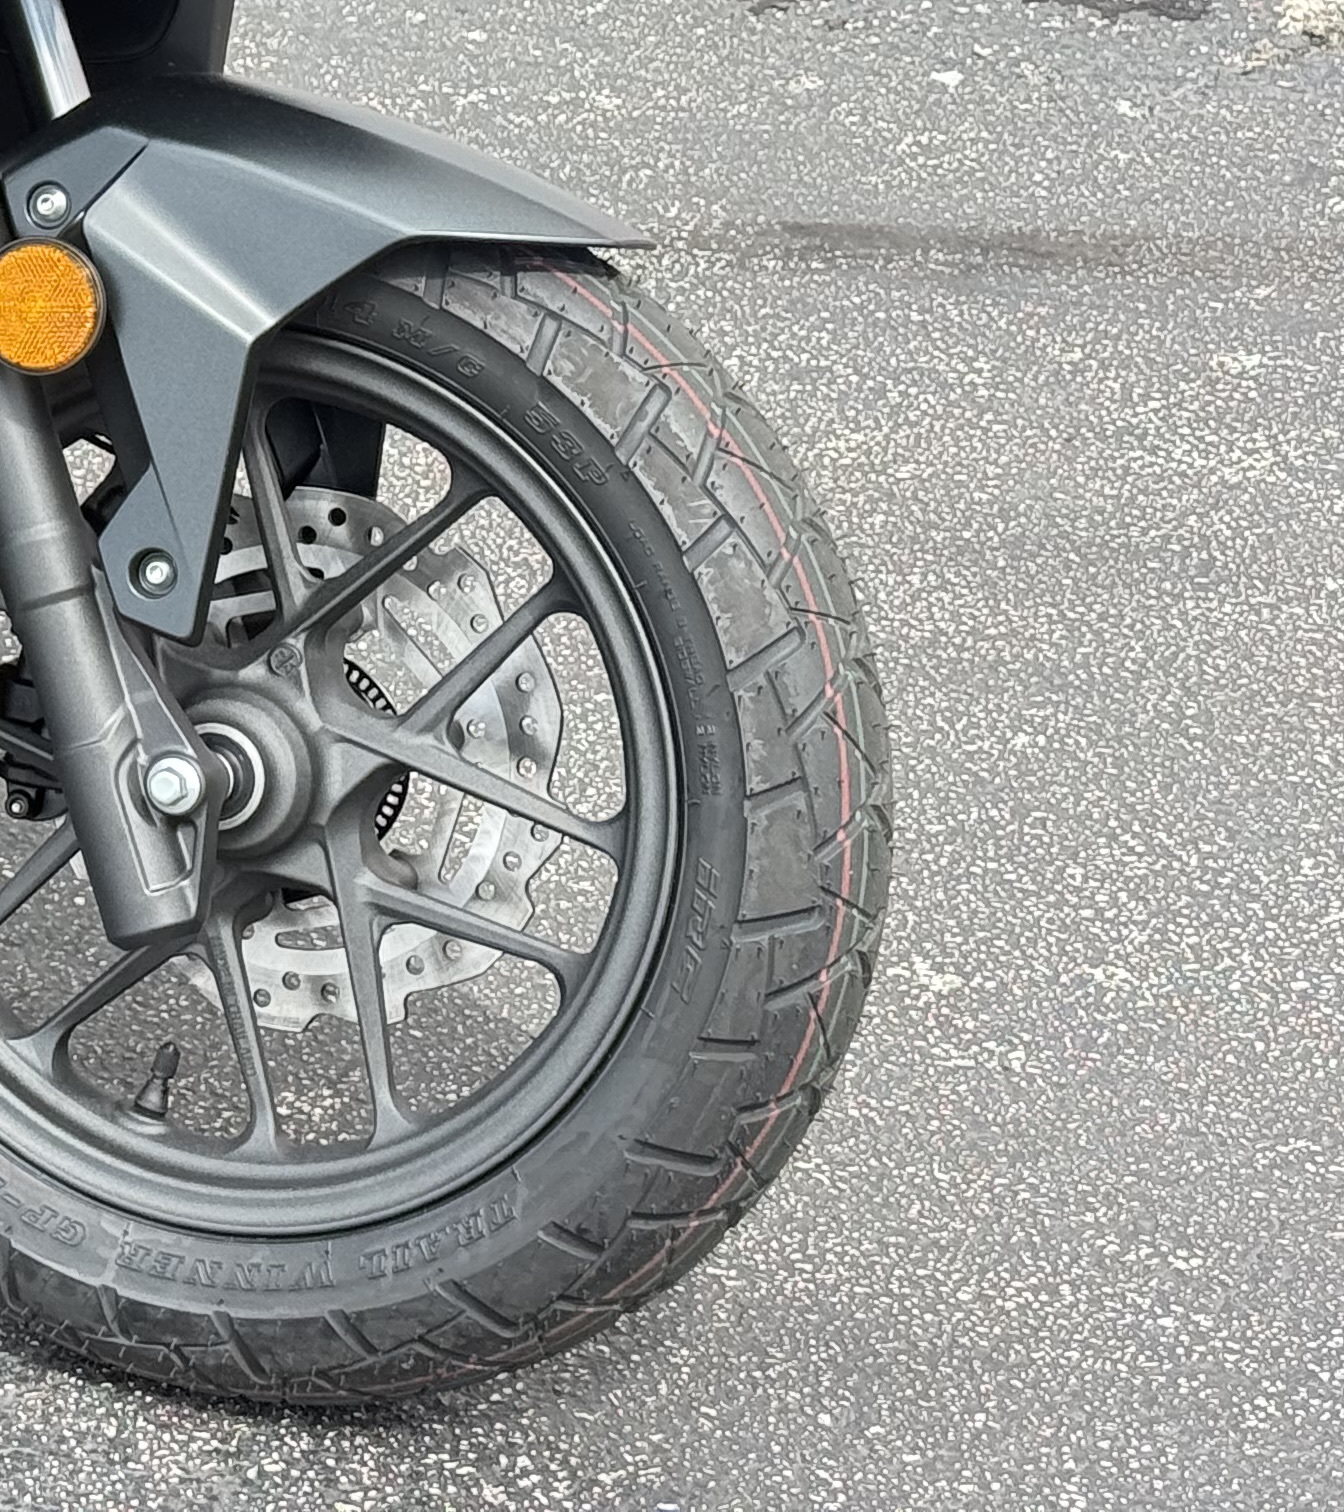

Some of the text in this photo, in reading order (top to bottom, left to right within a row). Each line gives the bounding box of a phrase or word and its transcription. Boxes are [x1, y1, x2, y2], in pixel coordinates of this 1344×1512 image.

[387, 313, 490, 385] M/C
[516, 392, 615, 497] 53P
[111, 1237, 338, 1294] WINNER
[353, 1191, 520, 1284] TRAIL
